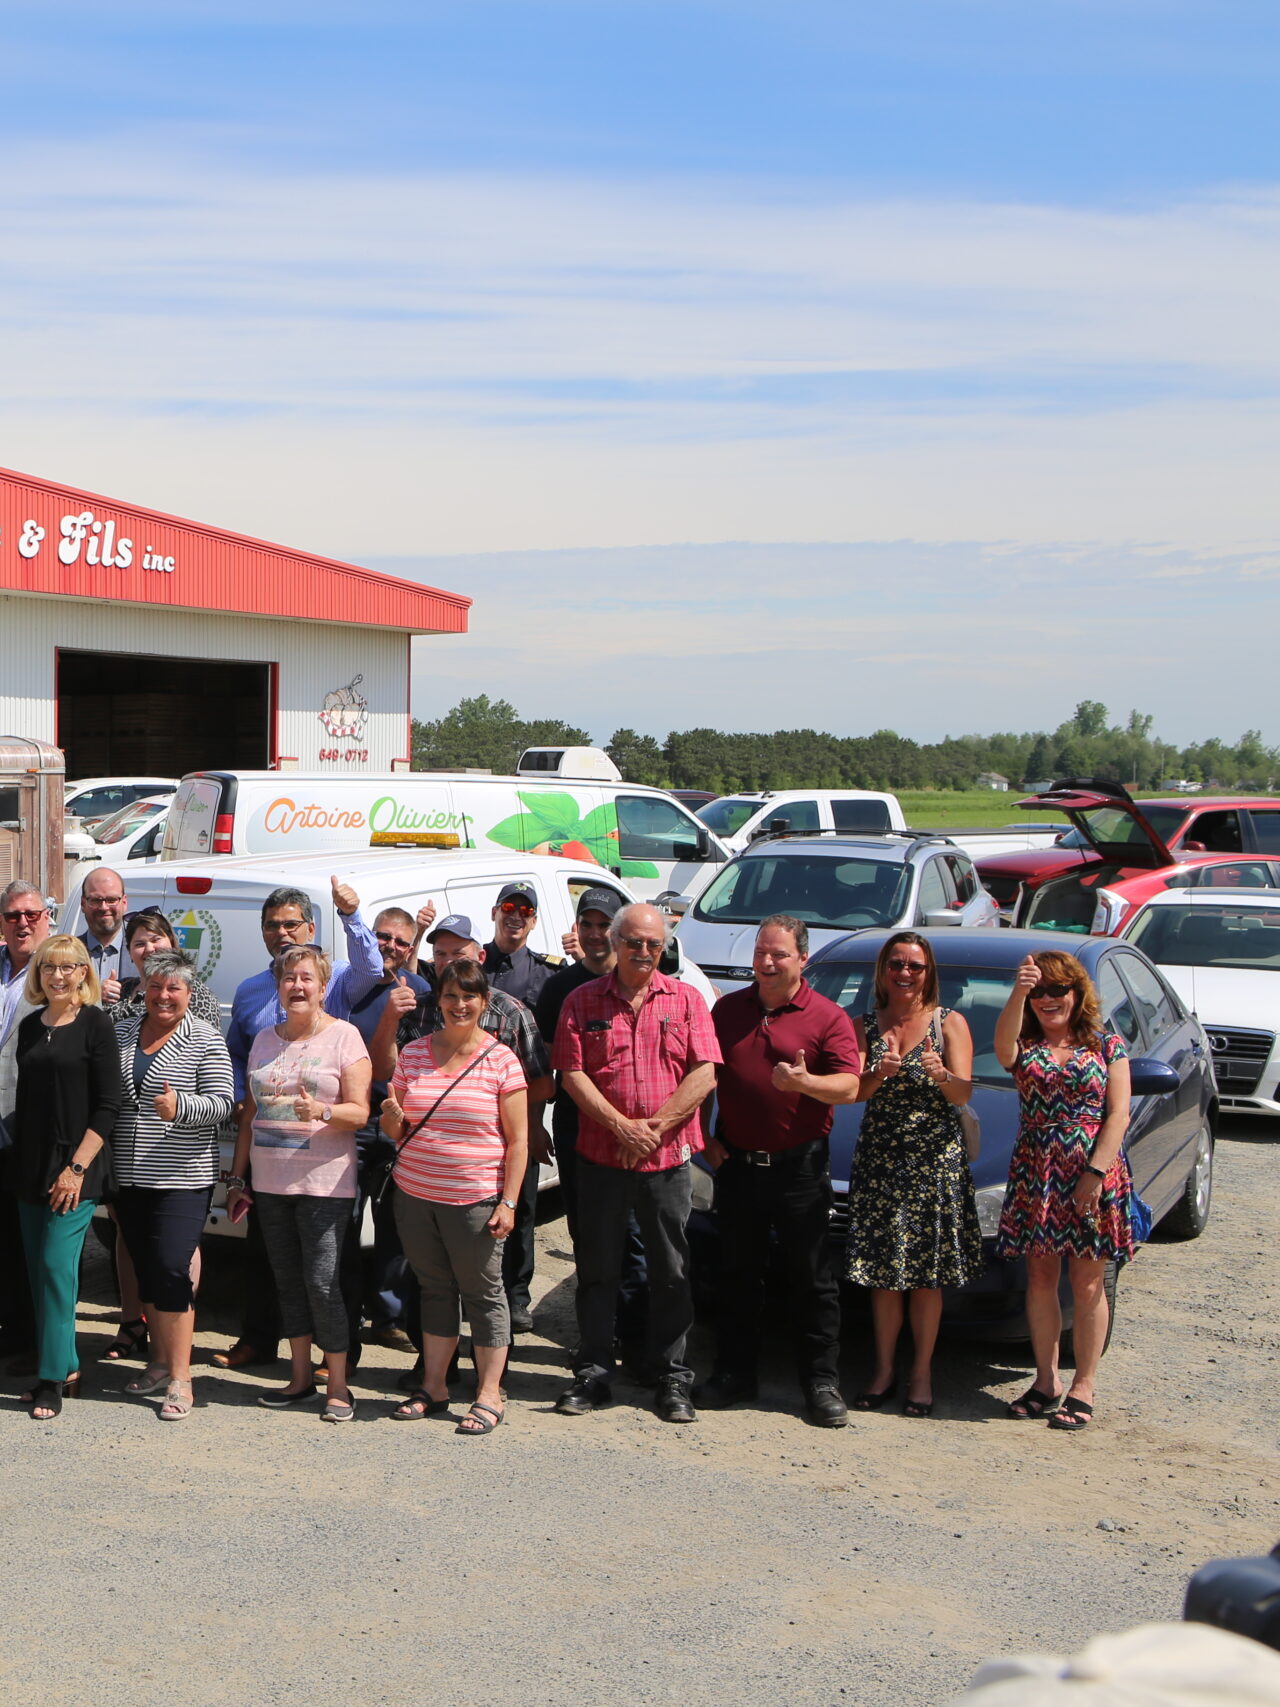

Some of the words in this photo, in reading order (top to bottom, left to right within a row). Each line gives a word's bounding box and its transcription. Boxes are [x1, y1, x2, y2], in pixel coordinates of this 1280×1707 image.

[19, 519, 45, 558] &
[58, 511, 133, 569] Fils
[142, 545, 175, 573] inc
[264, 797, 366, 834] Antoine
[369, 796, 474, 833] Olivier
